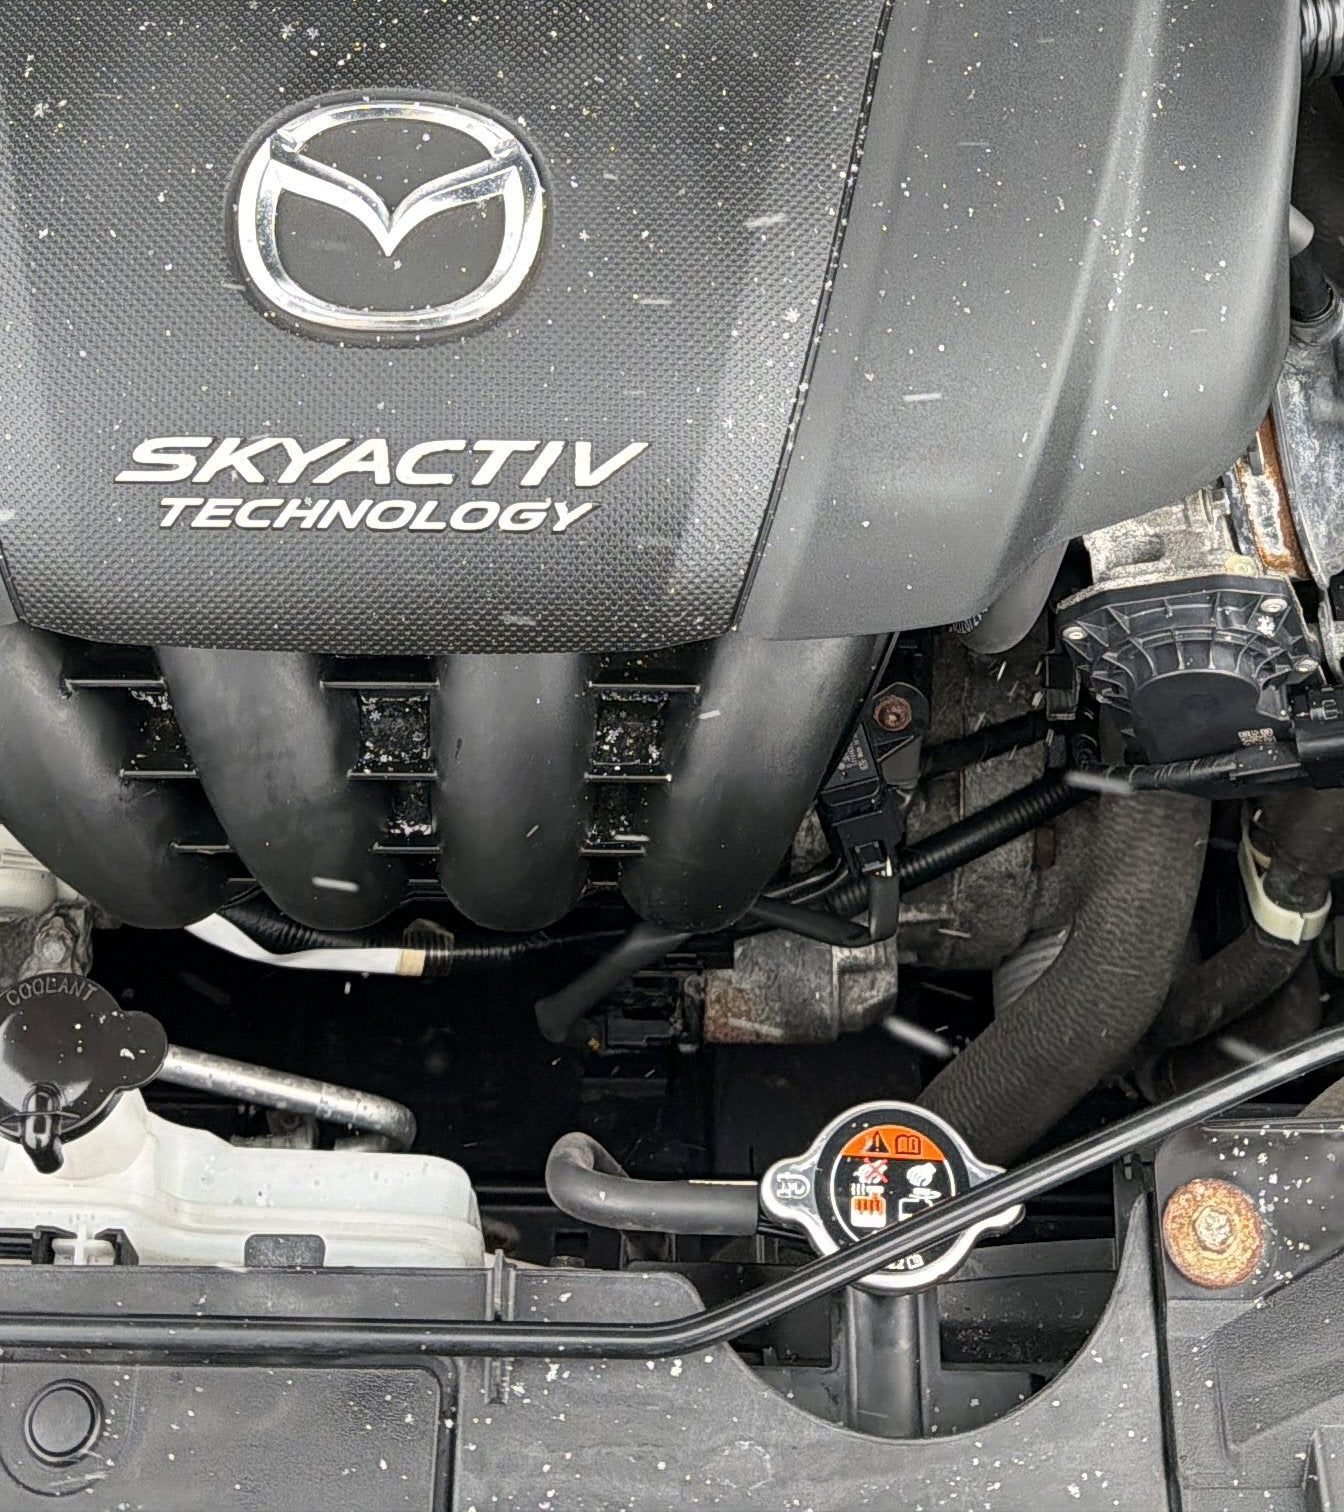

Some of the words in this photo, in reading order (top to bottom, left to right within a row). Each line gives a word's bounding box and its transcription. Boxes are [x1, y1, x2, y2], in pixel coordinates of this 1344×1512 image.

[115, 436, 651, 487] SKYACTIV
[158, 497, 601, 533] TECHNOLOGY
[5, 976, 99, 1007] COOLANT
